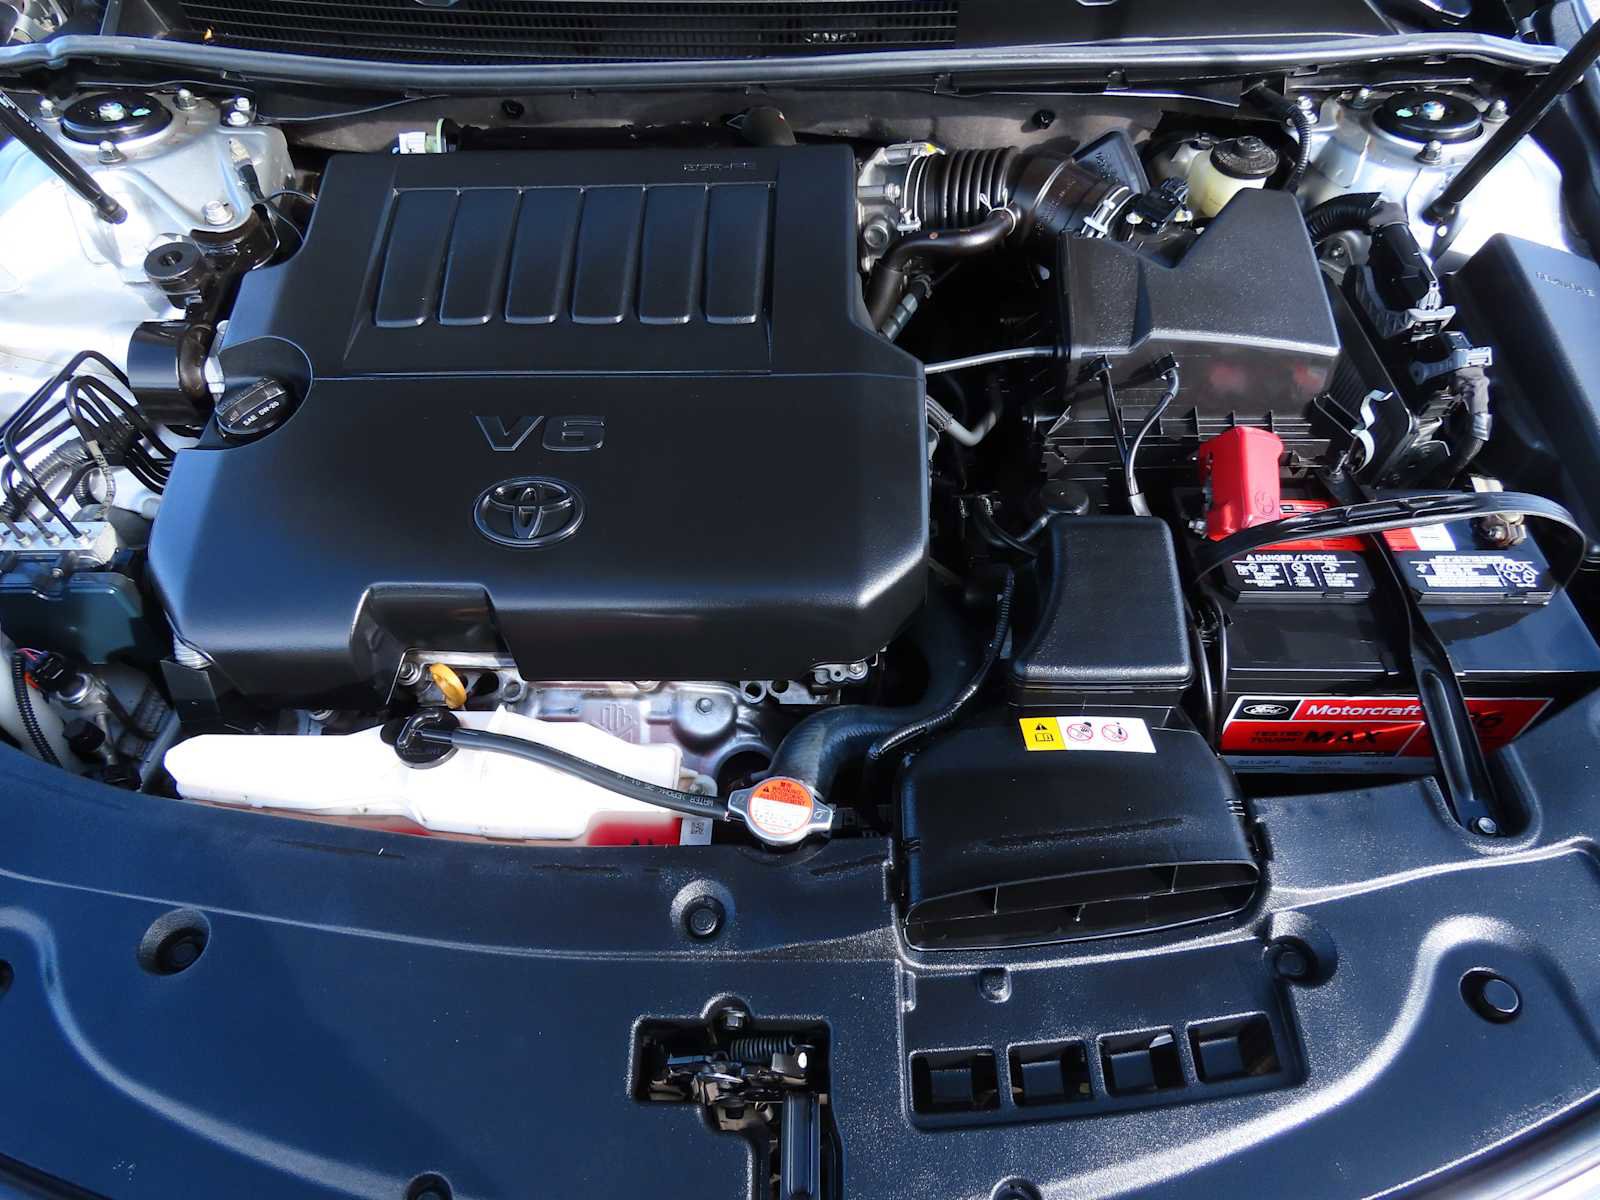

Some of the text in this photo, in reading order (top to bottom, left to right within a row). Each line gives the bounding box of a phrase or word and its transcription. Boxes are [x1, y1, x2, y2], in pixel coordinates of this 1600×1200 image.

[243, 415, 258, 426] SAE
[473, 415, 607, 452] V6
[1255, 554, 1294, 562] DANGER
[1250, 704, 1283, 715] Ford
[1306, 704, 1421, 717] Motorcraft
[1303, 731, 1382, 744] MAX
